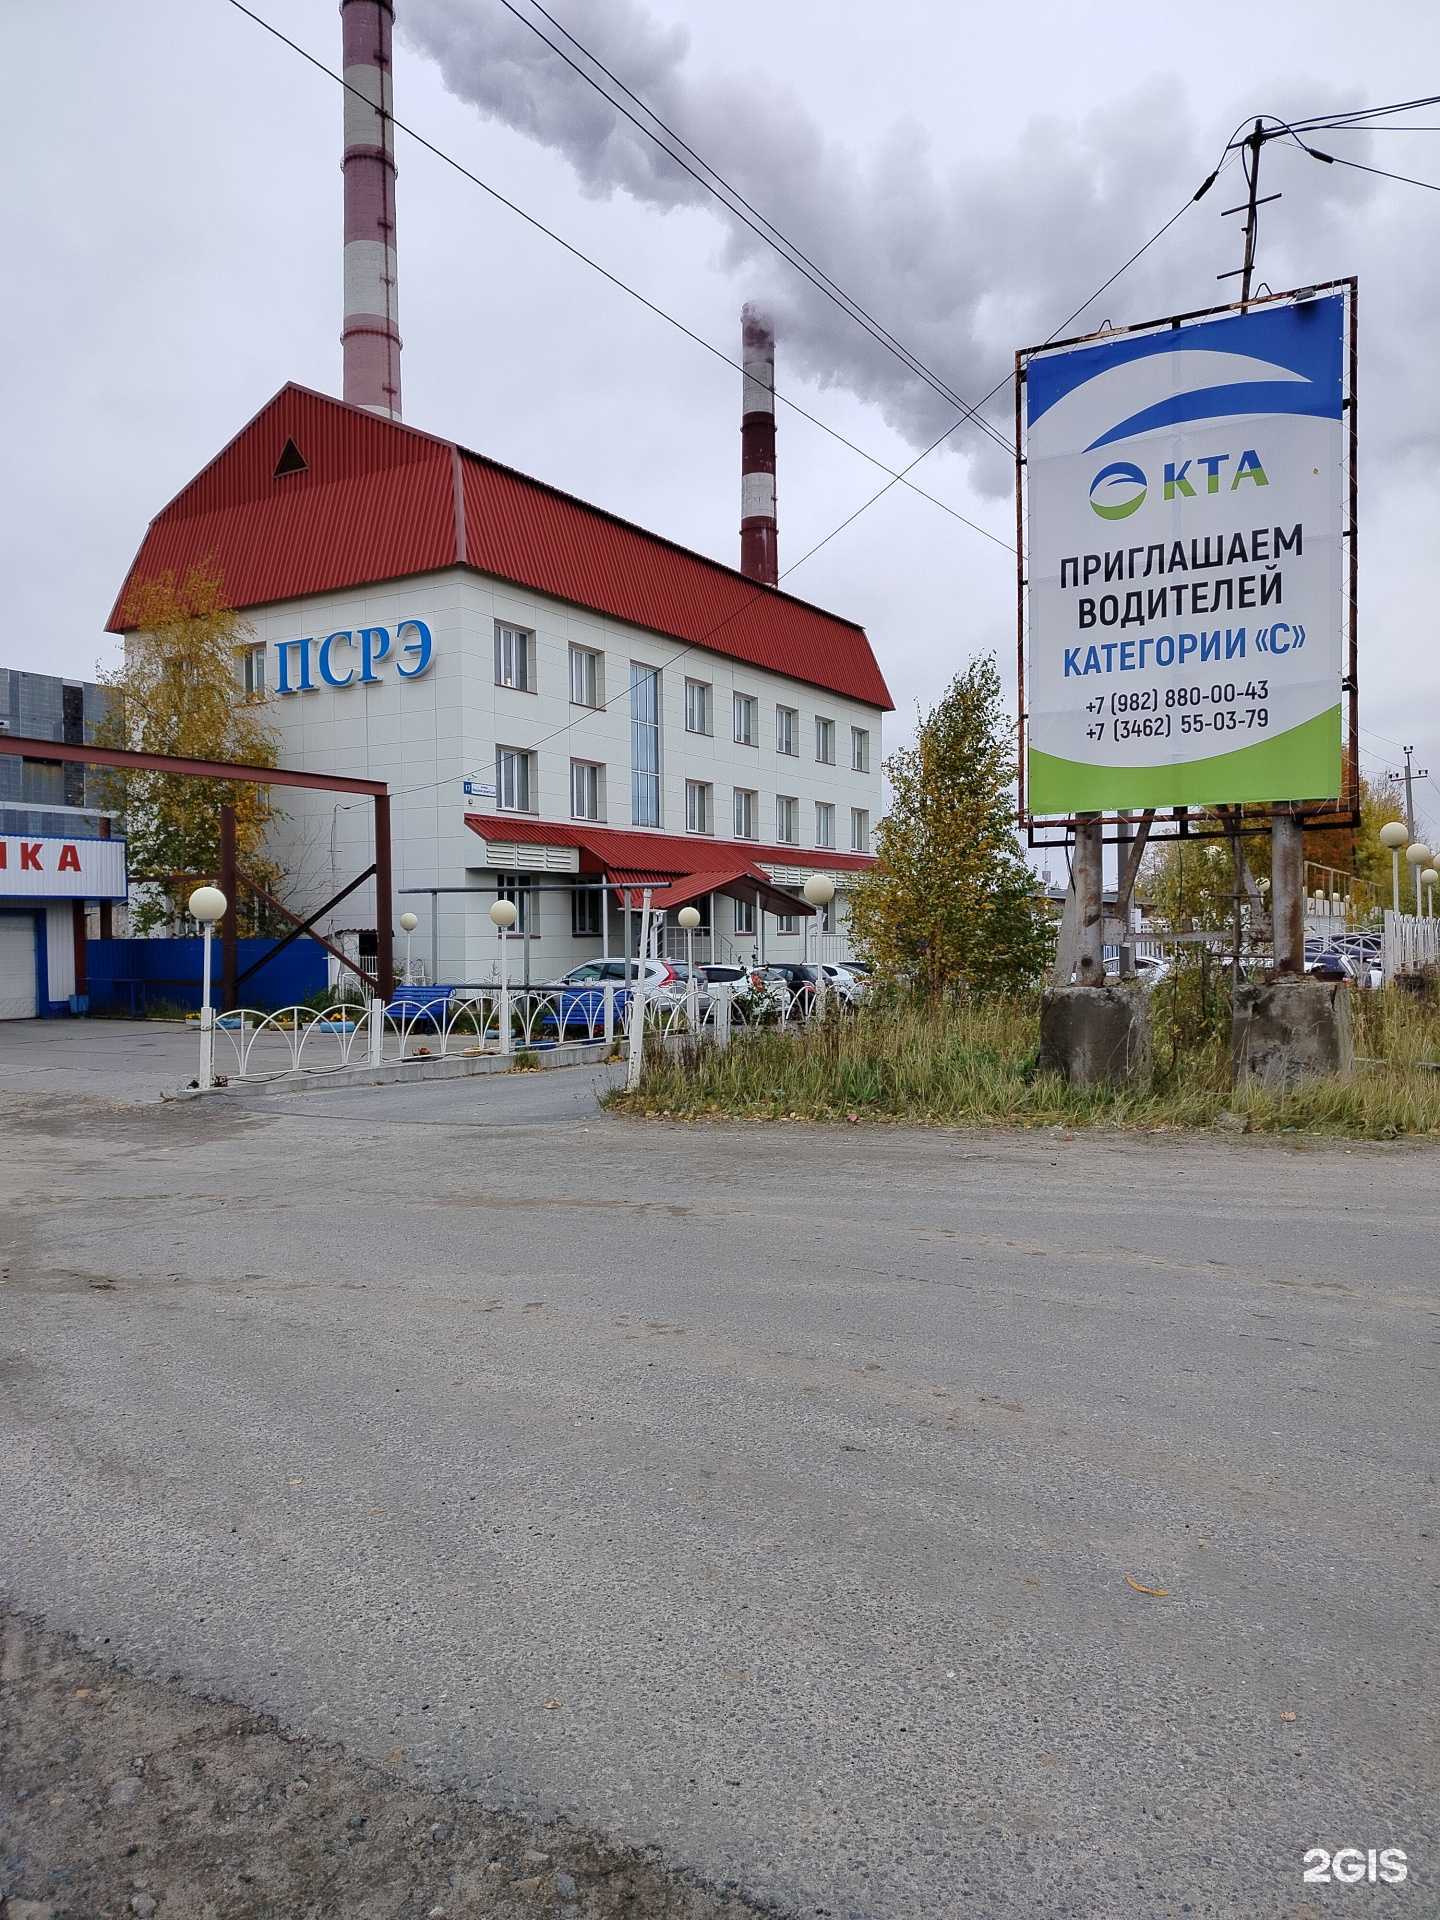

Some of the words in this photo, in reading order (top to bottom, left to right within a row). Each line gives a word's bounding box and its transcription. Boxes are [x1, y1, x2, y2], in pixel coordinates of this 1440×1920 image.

[1060, 523, 1303, 588] ПРИГЛАШАЕМ
[1079, 564, 1282, 629] ВОДИТЕЛЕЙ
[274, 619, 432, 694] ПСРЭ
[1064, 628, 1246, 677] КАТЕГОРИИ
[1255, 622, 1306, 654] «С»
[1086, 696, 1105, 714] +7
[1111, 688, 1158, 715] (982)
[1165, 680, 1268, 708] 880-00-43
[1086, 723, 1105, 740] +7
[1113, 714, 1171, 742] (3462)
[1181, 708, 1268, 734] 55-03-79
